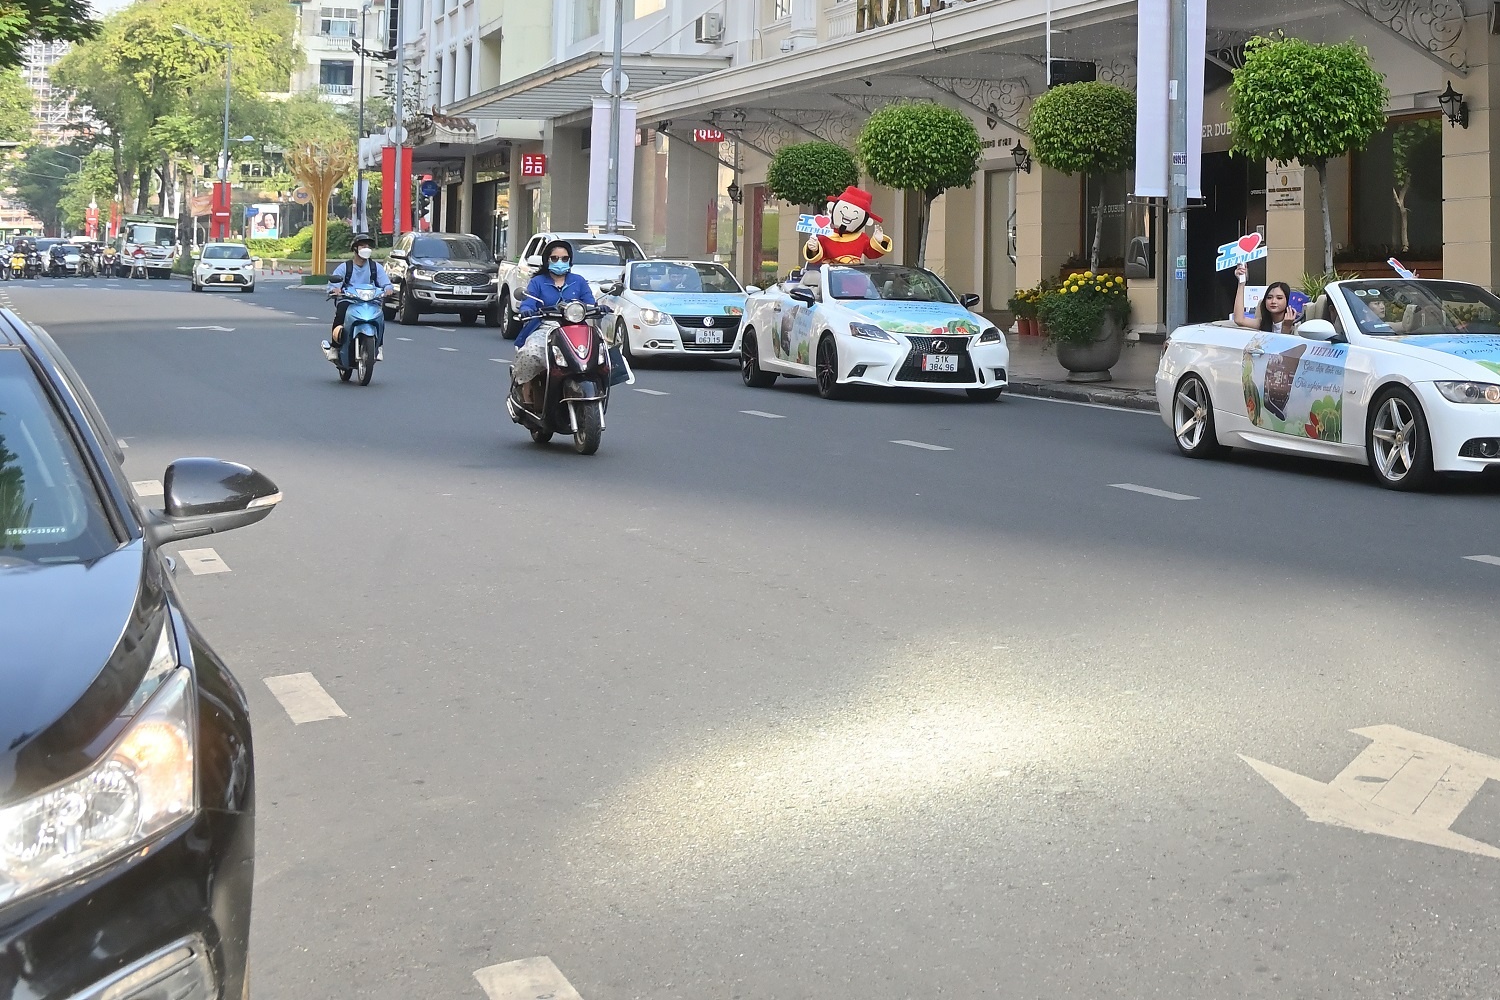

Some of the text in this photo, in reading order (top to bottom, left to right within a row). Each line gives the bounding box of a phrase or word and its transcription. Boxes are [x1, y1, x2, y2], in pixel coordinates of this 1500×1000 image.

[1201, 122, 1232, 138] ER DUB
[798, 215, 814, 226] I
[1217, 242, 1238, 261] I
[1217, 249, 1263, 270] VIETMAP
[1310, 346, 1344, 358] VIETMAP
[935, 355, 949, 363] 51K
[929, 363, 954, 371] 384.96
